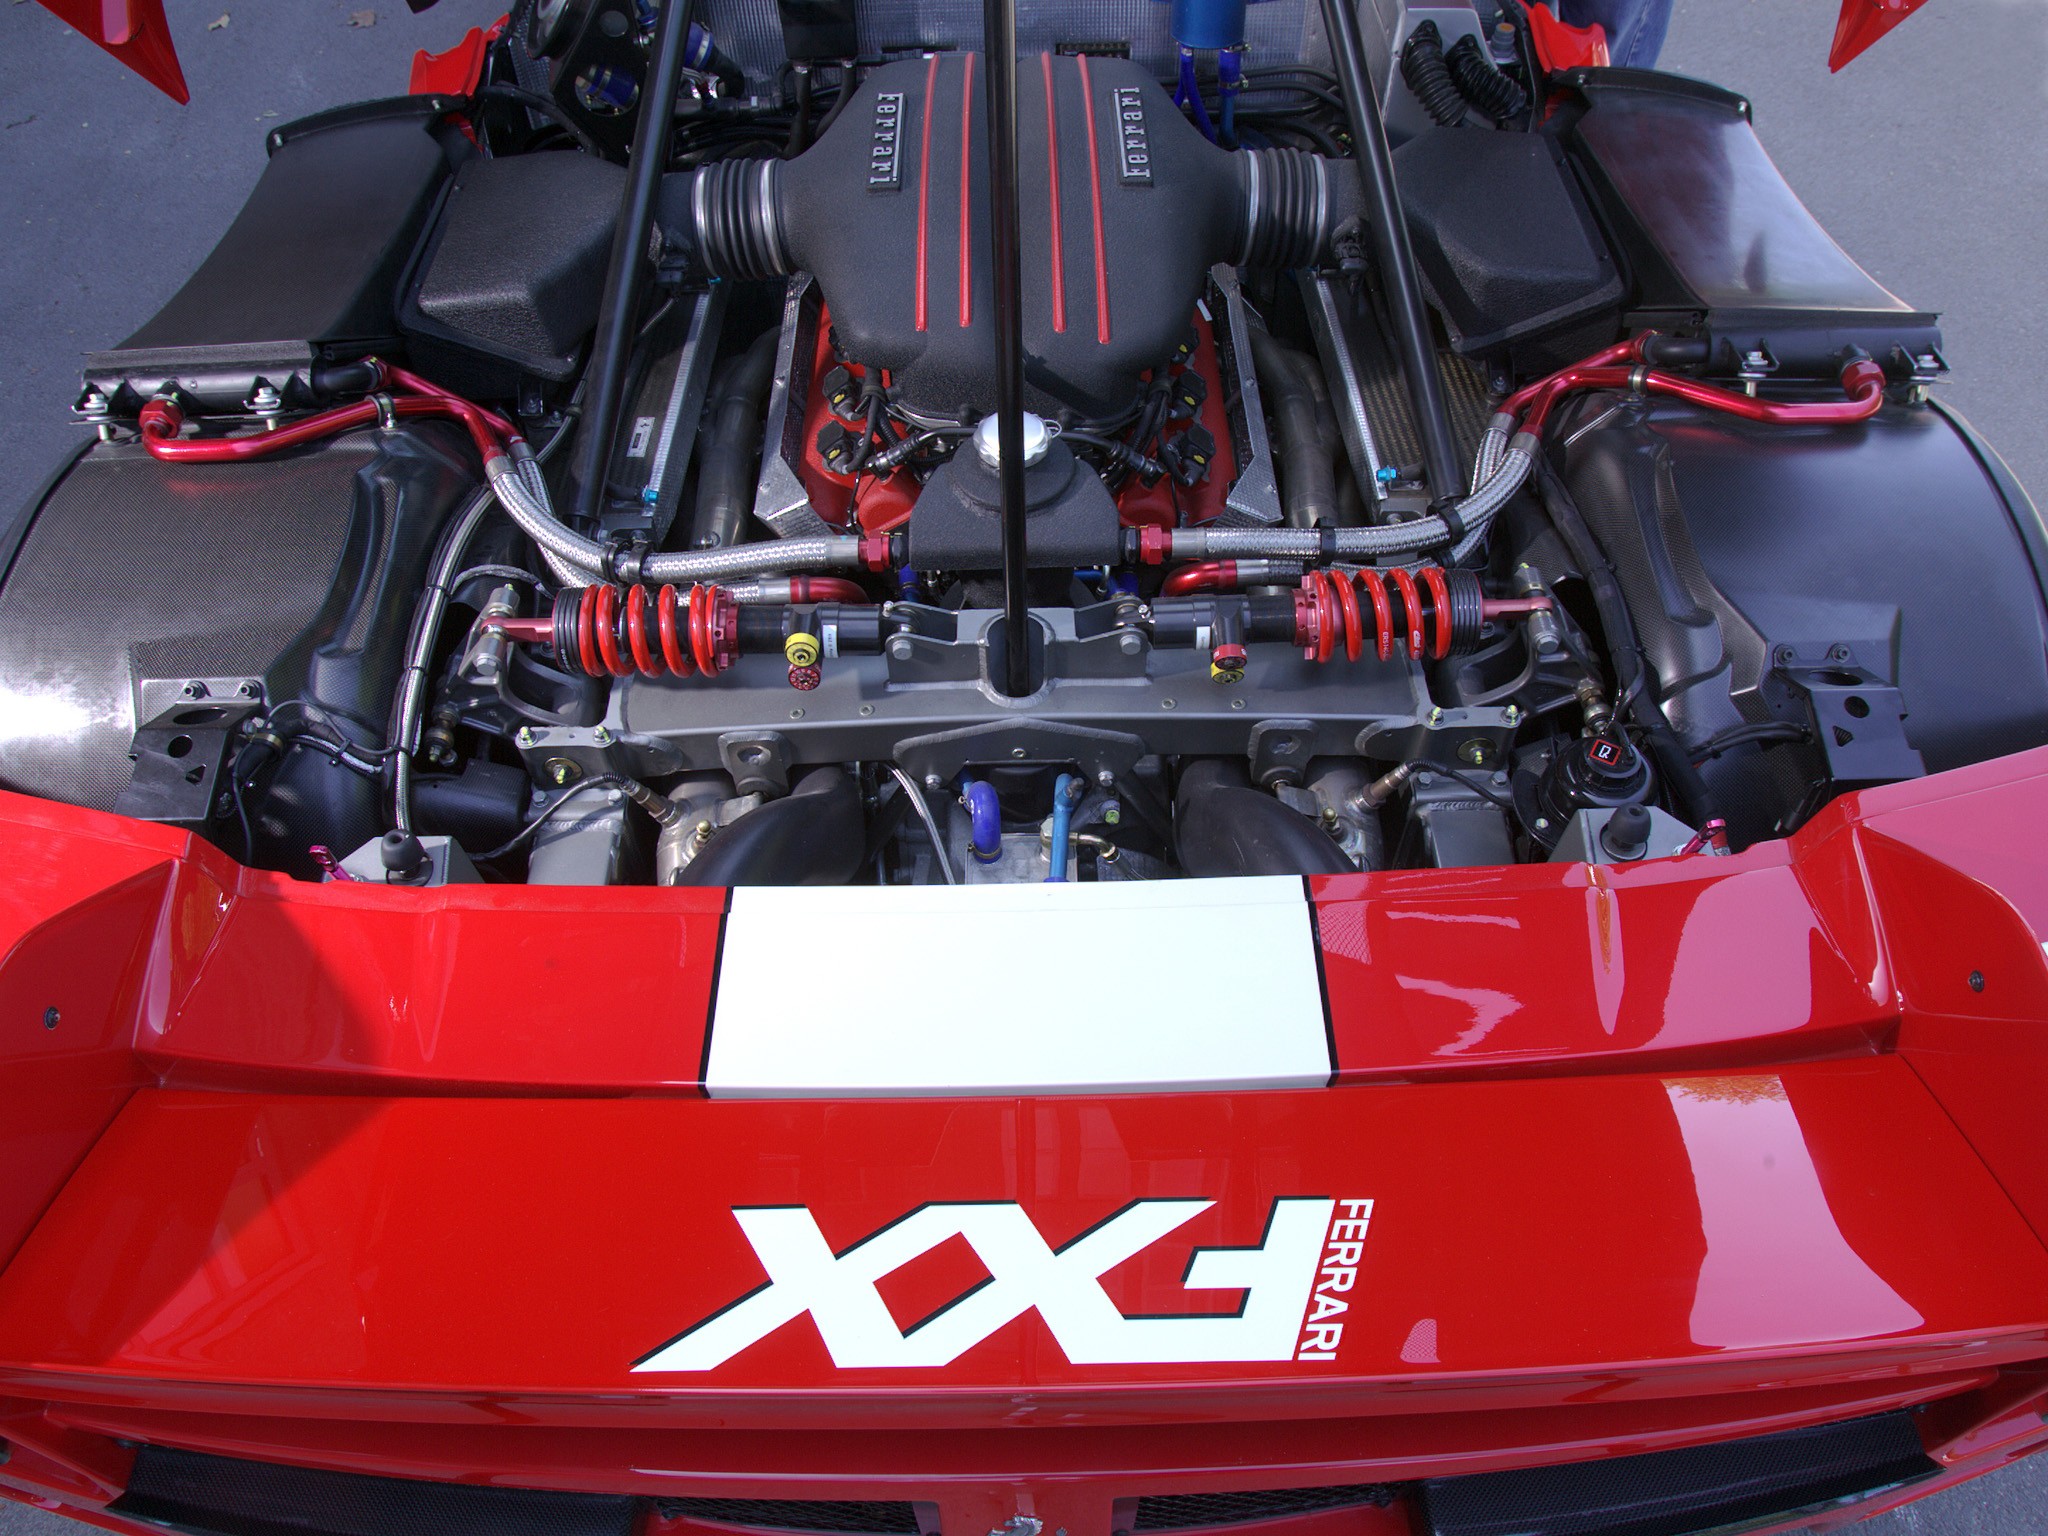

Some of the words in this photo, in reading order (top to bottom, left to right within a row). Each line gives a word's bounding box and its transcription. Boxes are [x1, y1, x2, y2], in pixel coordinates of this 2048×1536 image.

[870, 93, 904, 184] Ferrari
[1113, 87, 1151, 178] Ferrari
[630, 1195, 1335, 1372] FXX
[1298, 1199, 1374, 1361] FERRARI
